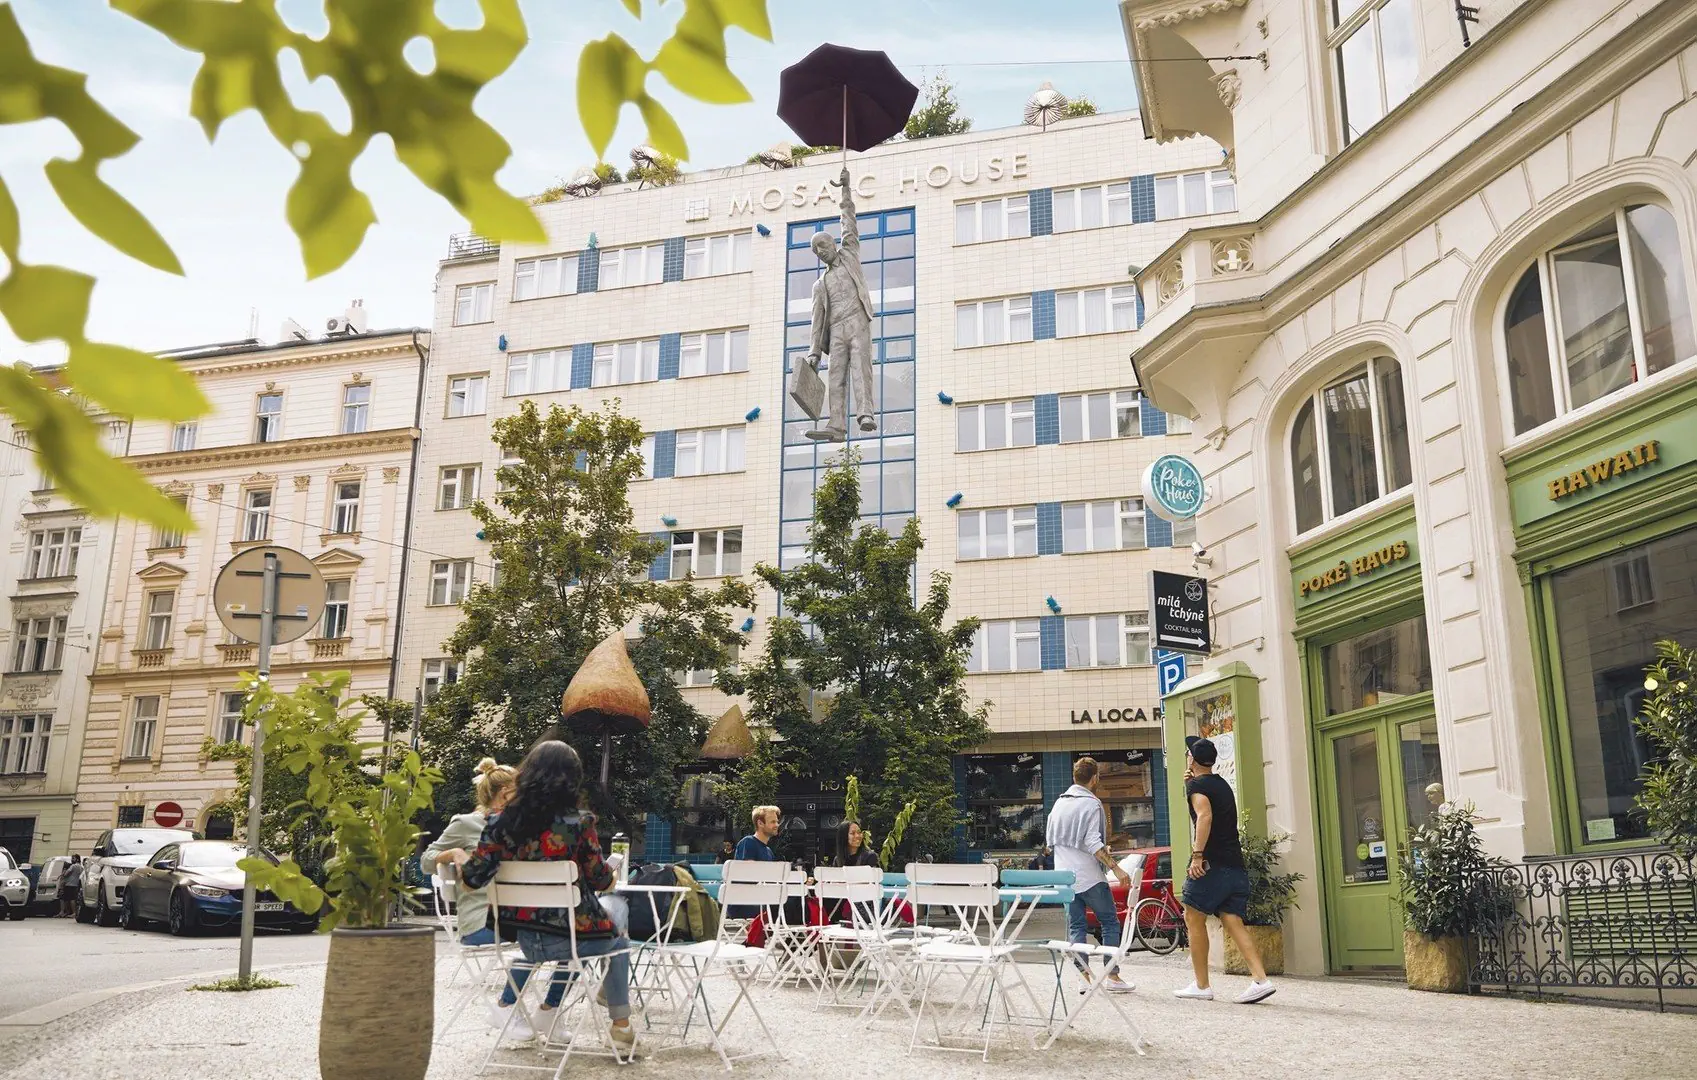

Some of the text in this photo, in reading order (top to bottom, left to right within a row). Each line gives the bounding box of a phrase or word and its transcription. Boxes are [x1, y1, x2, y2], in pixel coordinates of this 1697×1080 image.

[728, 154, 1033, 218] MOSAC HOUSE
[1547, 439, 1660, 501] HAWAII
[1165, 482, 1195, 504] Haus
[1300, 540, 1409, 598] POKÉ HAUS
[1157, 595, 1181, 608] milá
[1169, 607, 1205, 622] tchýně
[1164, 623, 1203, 635] COCKTAIL BAR
[1163, 663, 1180, 694] P
[1071, 707, 1161, 724] LA LOCA R
